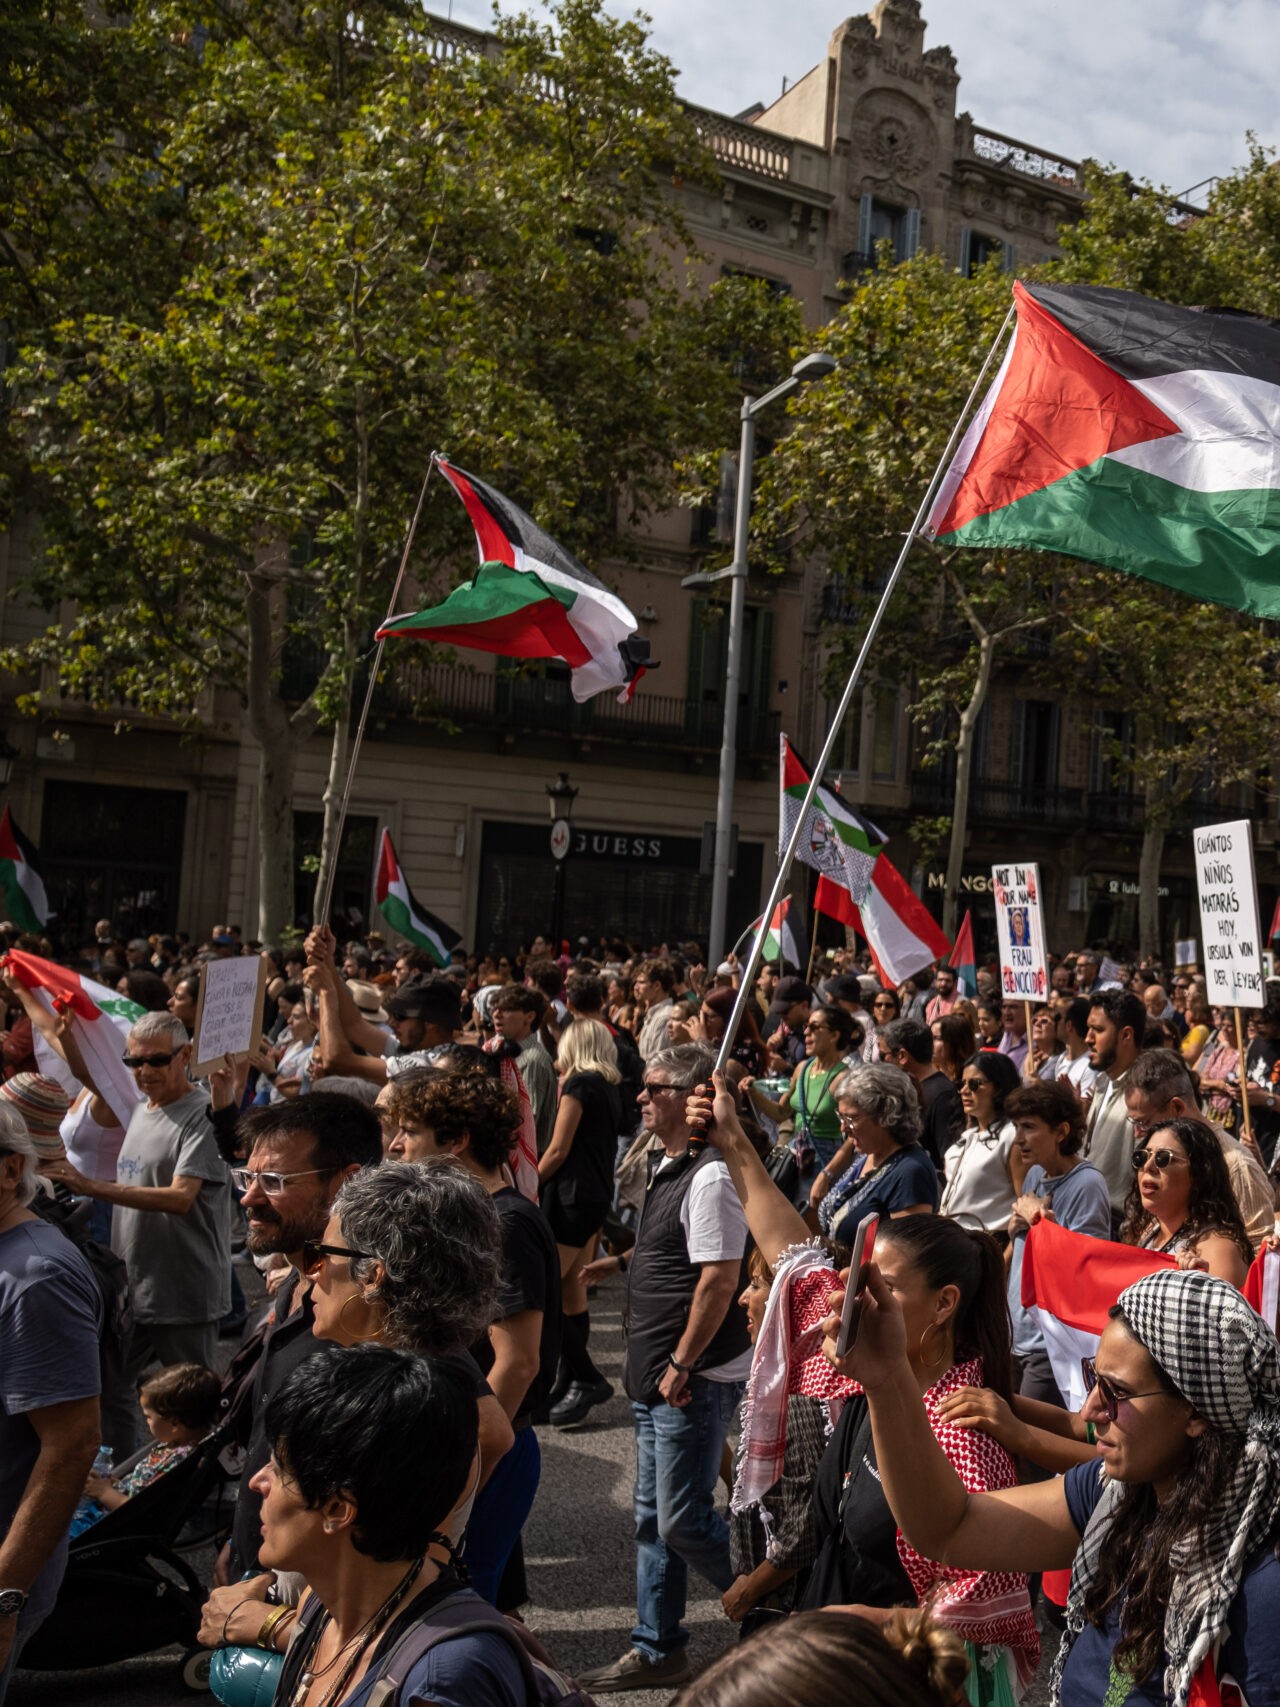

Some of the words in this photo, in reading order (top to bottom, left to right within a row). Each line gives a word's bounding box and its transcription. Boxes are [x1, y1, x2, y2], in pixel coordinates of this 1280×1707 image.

[928, 871, 993, 892] MNG
[996, 869, 1009, 886] NOT
[1015, 866, 1026, 886] IN
[1203, 860, 1233, 884] NIÑOS
[1003, 890, 1017, 906] OUR
[1018, 890, 1037, 905] NAME
[1011, 948, 1033, 966] FRAU
[1206, 944, 1234, 961] URSULA
[1239, 941, 1253, 957] VON
[1003, 969, 1044, 996] GENOCIDE
[1213, 968, 1228, 986] DER
[1232, 969, 1261, 992] LEYEN?
